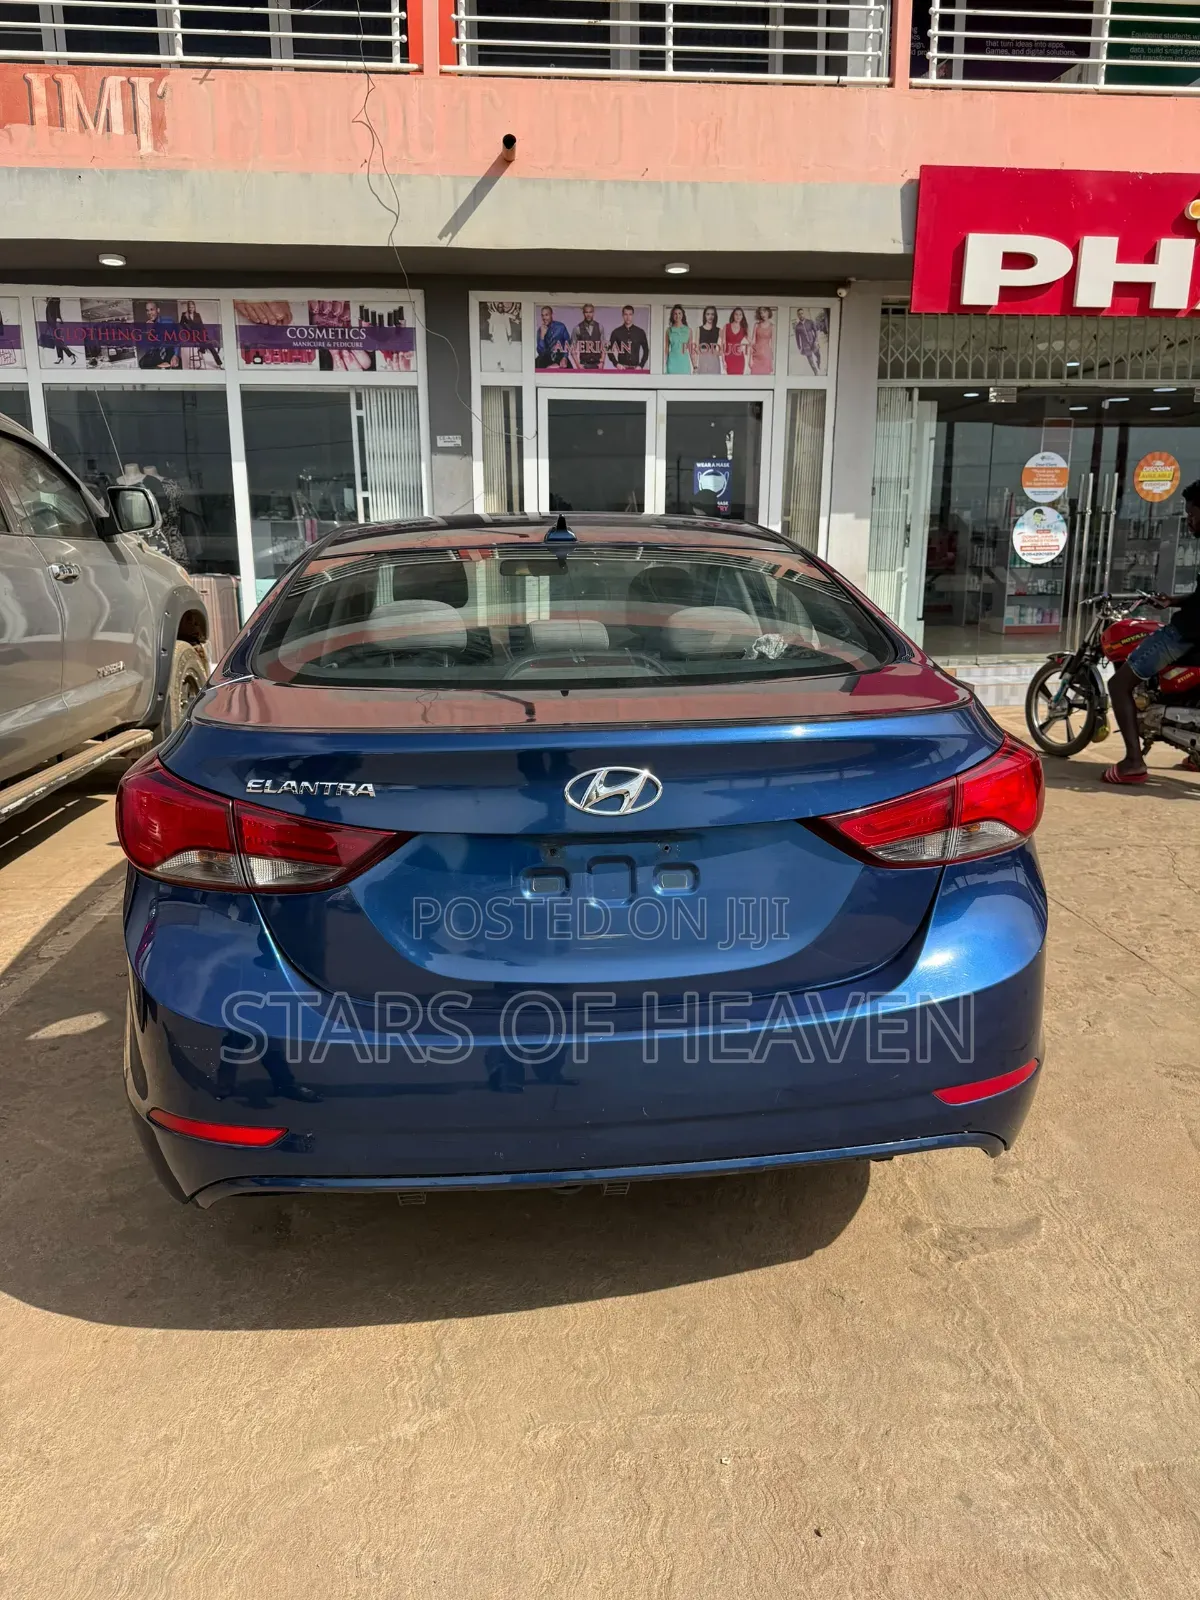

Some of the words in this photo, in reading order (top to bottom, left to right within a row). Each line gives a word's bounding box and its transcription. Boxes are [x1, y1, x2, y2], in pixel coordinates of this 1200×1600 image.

[1025, 48, 1045, 57] digital
[960, 232, 1200, 309] PH
[53, 327, 142, 342] CLOTHING
[147, 328, 159, 342] &
[164, 328, 210, 342] MORE
[286, 327, 367, 340] COSMETICS
[553, 340, 632, 354] AMERICAN
[681, 343, 758, 357] PRODUCTS
[1140, 472, 1173, 480] AVAILABLE
[1143, 465, 1175, 473] DISCOUNT
[245, 779, 376, 797] ELANTRA
